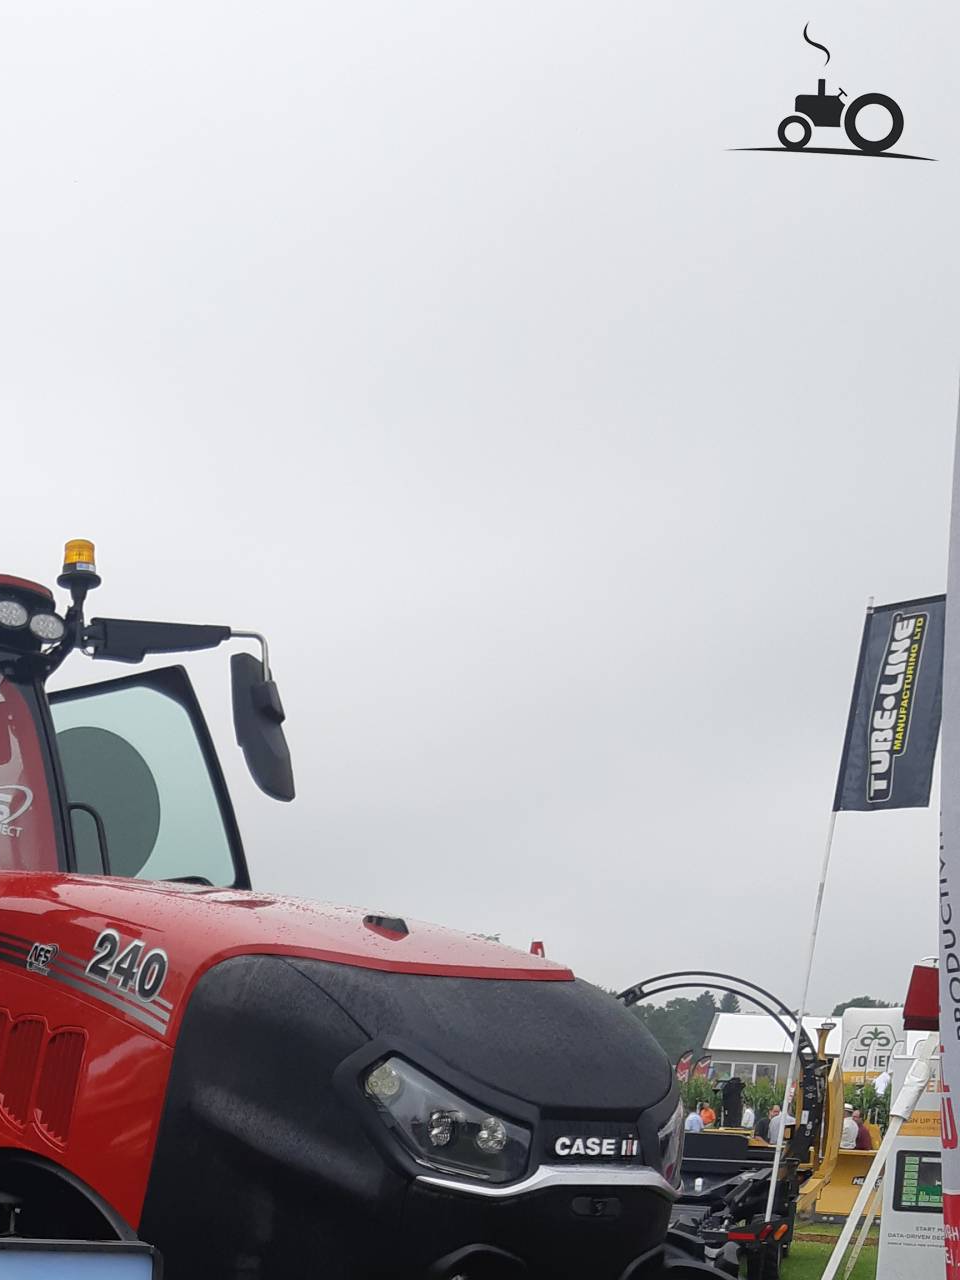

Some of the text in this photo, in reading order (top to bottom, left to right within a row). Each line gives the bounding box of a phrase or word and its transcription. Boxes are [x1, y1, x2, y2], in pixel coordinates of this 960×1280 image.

[893, 617, 925, 750] MANUFACTURING LTD
[28, 943, 51, 966] AFS
[85, 928, 168, 1002] 240
[555, 1137, 616, 1156] CASE
